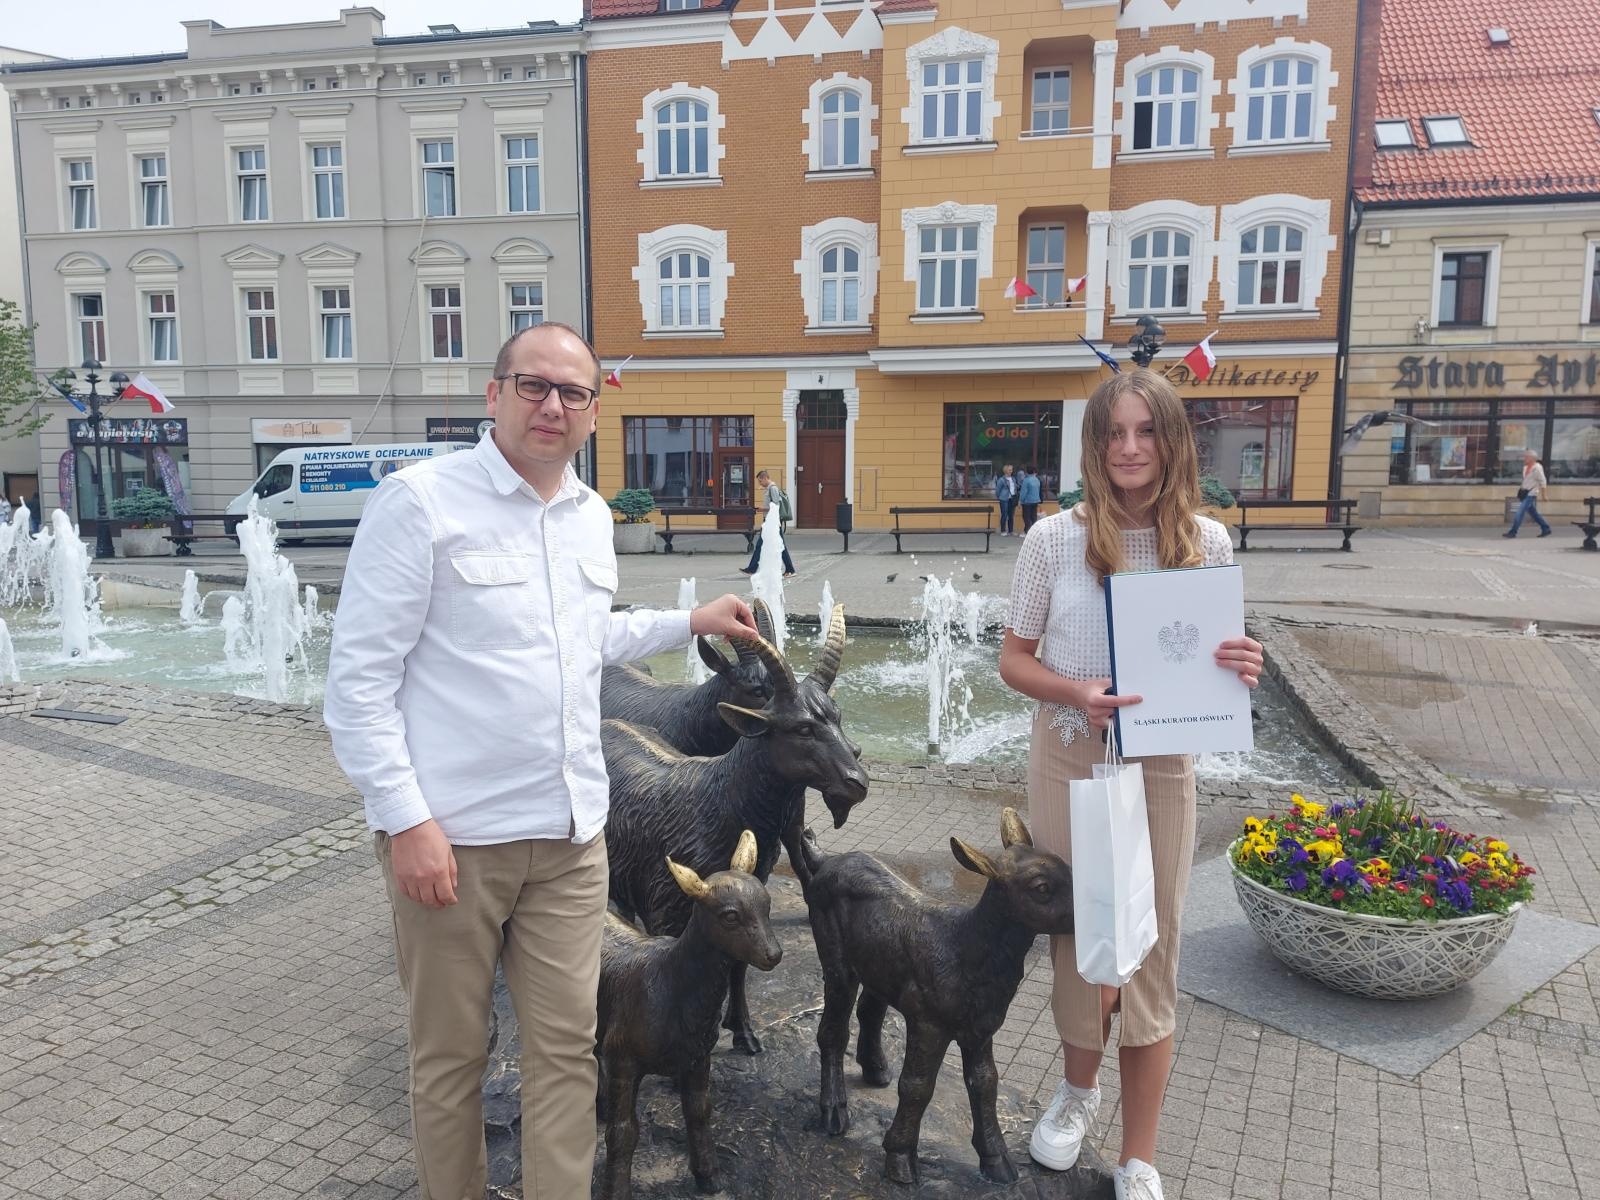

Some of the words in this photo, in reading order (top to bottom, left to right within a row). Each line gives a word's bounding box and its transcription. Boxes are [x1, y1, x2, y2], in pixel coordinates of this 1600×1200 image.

[1391, 355, 1505, 390] Stara
[304, 451, 370, 461] NATRYSKOWE
[375, 448, 434, 458] OCIEPLANIE
[1134, 717, 1160, 726] ŚLĄSKI
[1162, 716, 1198, 724] KURATOR
